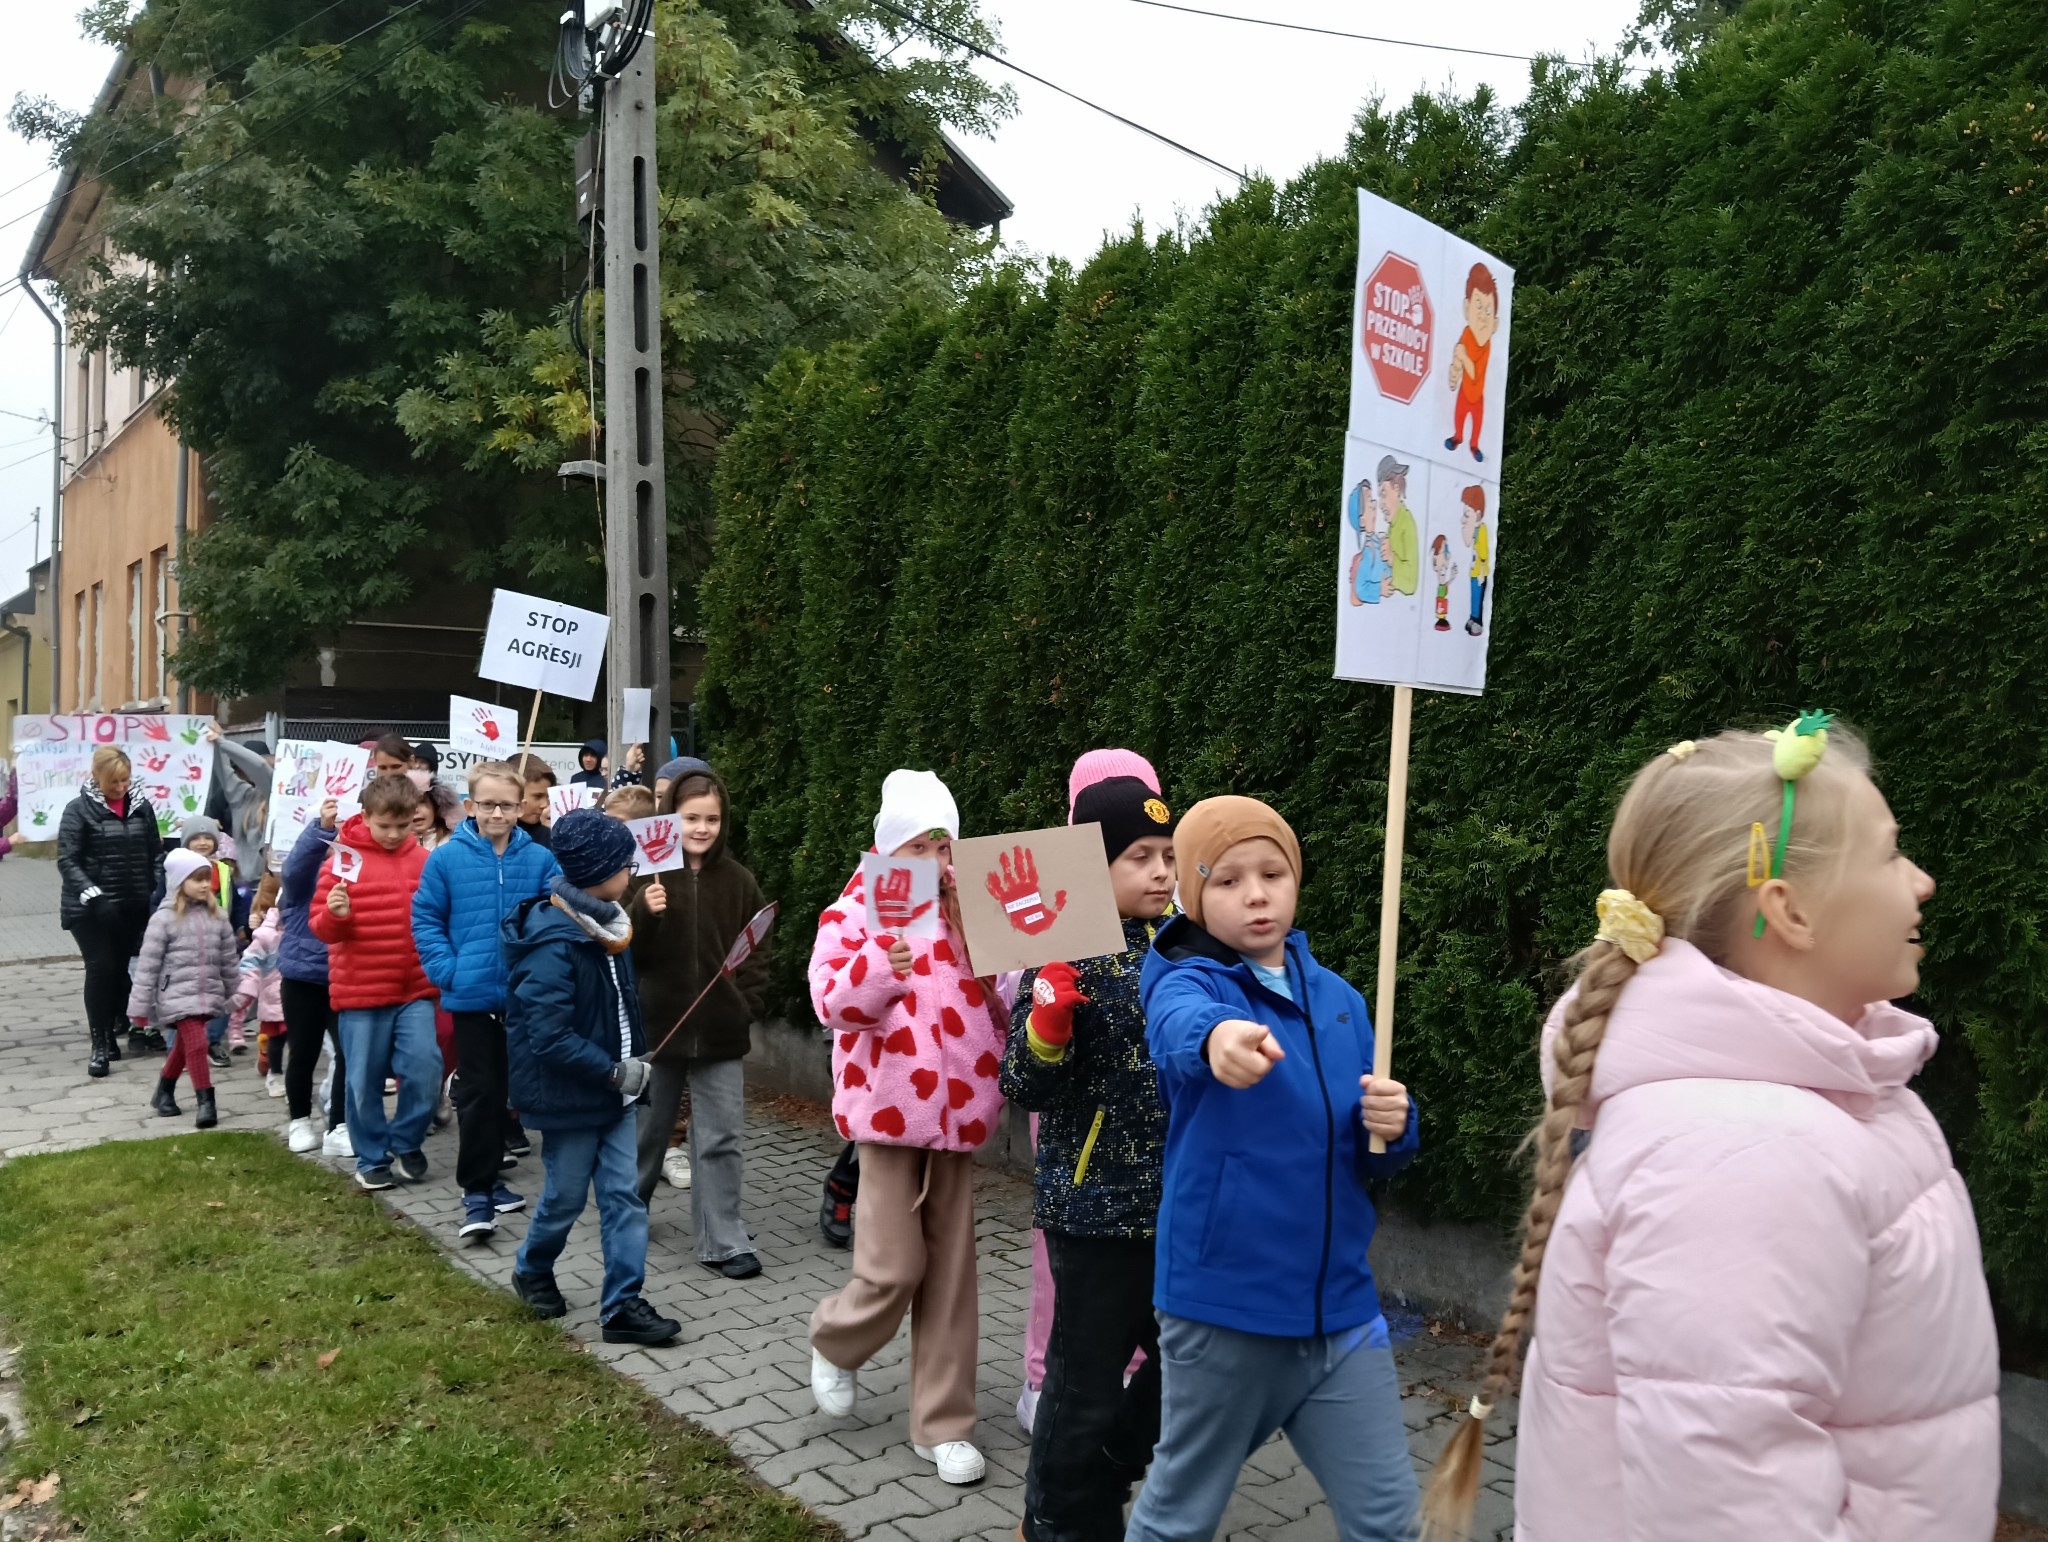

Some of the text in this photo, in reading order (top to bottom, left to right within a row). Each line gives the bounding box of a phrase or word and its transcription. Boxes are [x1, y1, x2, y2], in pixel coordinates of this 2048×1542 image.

[1373, 282, 1410, 318] STOP
[1367, 310, 1429, 353] PRZEMOCY
[1382, 342, 1424, 376] SZKOLE
[527, 611, 579, 636] STOP
[507, 637, 583, 670] AGRESJI
[46, 713, 141, 743] STOP
[283, 743, 316, 760] Nie
[277, 780, 308, 797] tak
